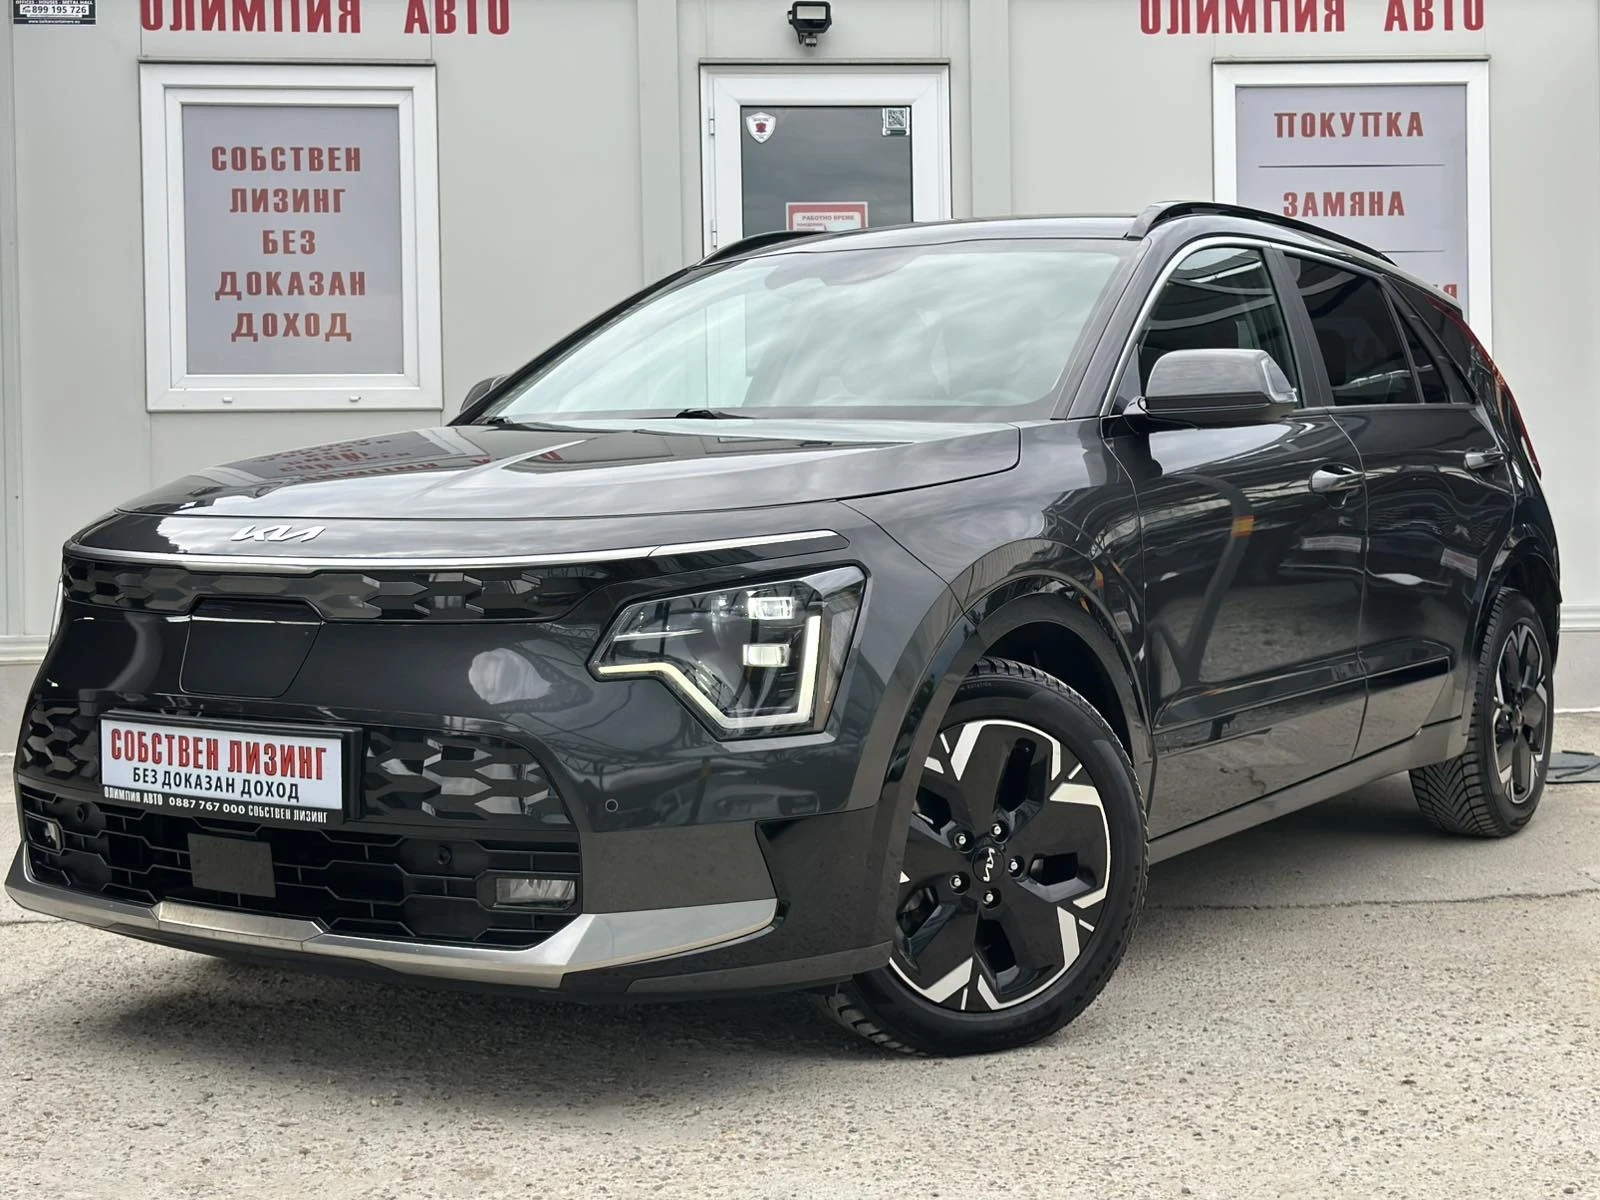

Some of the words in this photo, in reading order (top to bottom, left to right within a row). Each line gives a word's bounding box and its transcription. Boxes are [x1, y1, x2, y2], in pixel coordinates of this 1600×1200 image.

[32, 6, 49, 14] 899
[52, 6, 68, 14] 195
[70, 6, 87, 14] 726
[140, 0, 362, 34] ОЛИМПИЯ
[403, 0, 511, 36] АВТО
[1140, 0, 1346, 35] ОЛИМПИЯ
[1384, 0, 1486, 32] АВТО
[1274, 111, 1424, 138] ПОКУПКА
[211, 146, 361, 172] СОБСТВЕН
[230, 188, 346, 213] ЛИЗИНГ
[1283, 191, 1405, 218] ЗАМЯНА
[262, 230, 316, 255] БЕЗ
[215, 271, 366, 300] ДОКАЗАН
[231, 312, 352, 342] ДОХОД
[230, 524, 327, 543] KIA
[111, 728, 219, 772] СОБСТВЕН
[227, 739, 327, 781] ЛИЗИНГ
[133, 767, 158, 785] БЕЗ
[162, 770, 235, 793] ДОКАЗАН
[241, 778, 299, 803] ДОХОД
[104, 786, 141, 803] ОЛИМПИЯ
[143, 791, 163, 806] АВТО
[169, 797, 196, 809] 0887
[199, 800, 220, 812] 767
[222, 803, 246, 815] 000
[248, 804, 291, 820] СОБСТВЕН
[293, 809, 328, 823] ЛИЗИНГ
